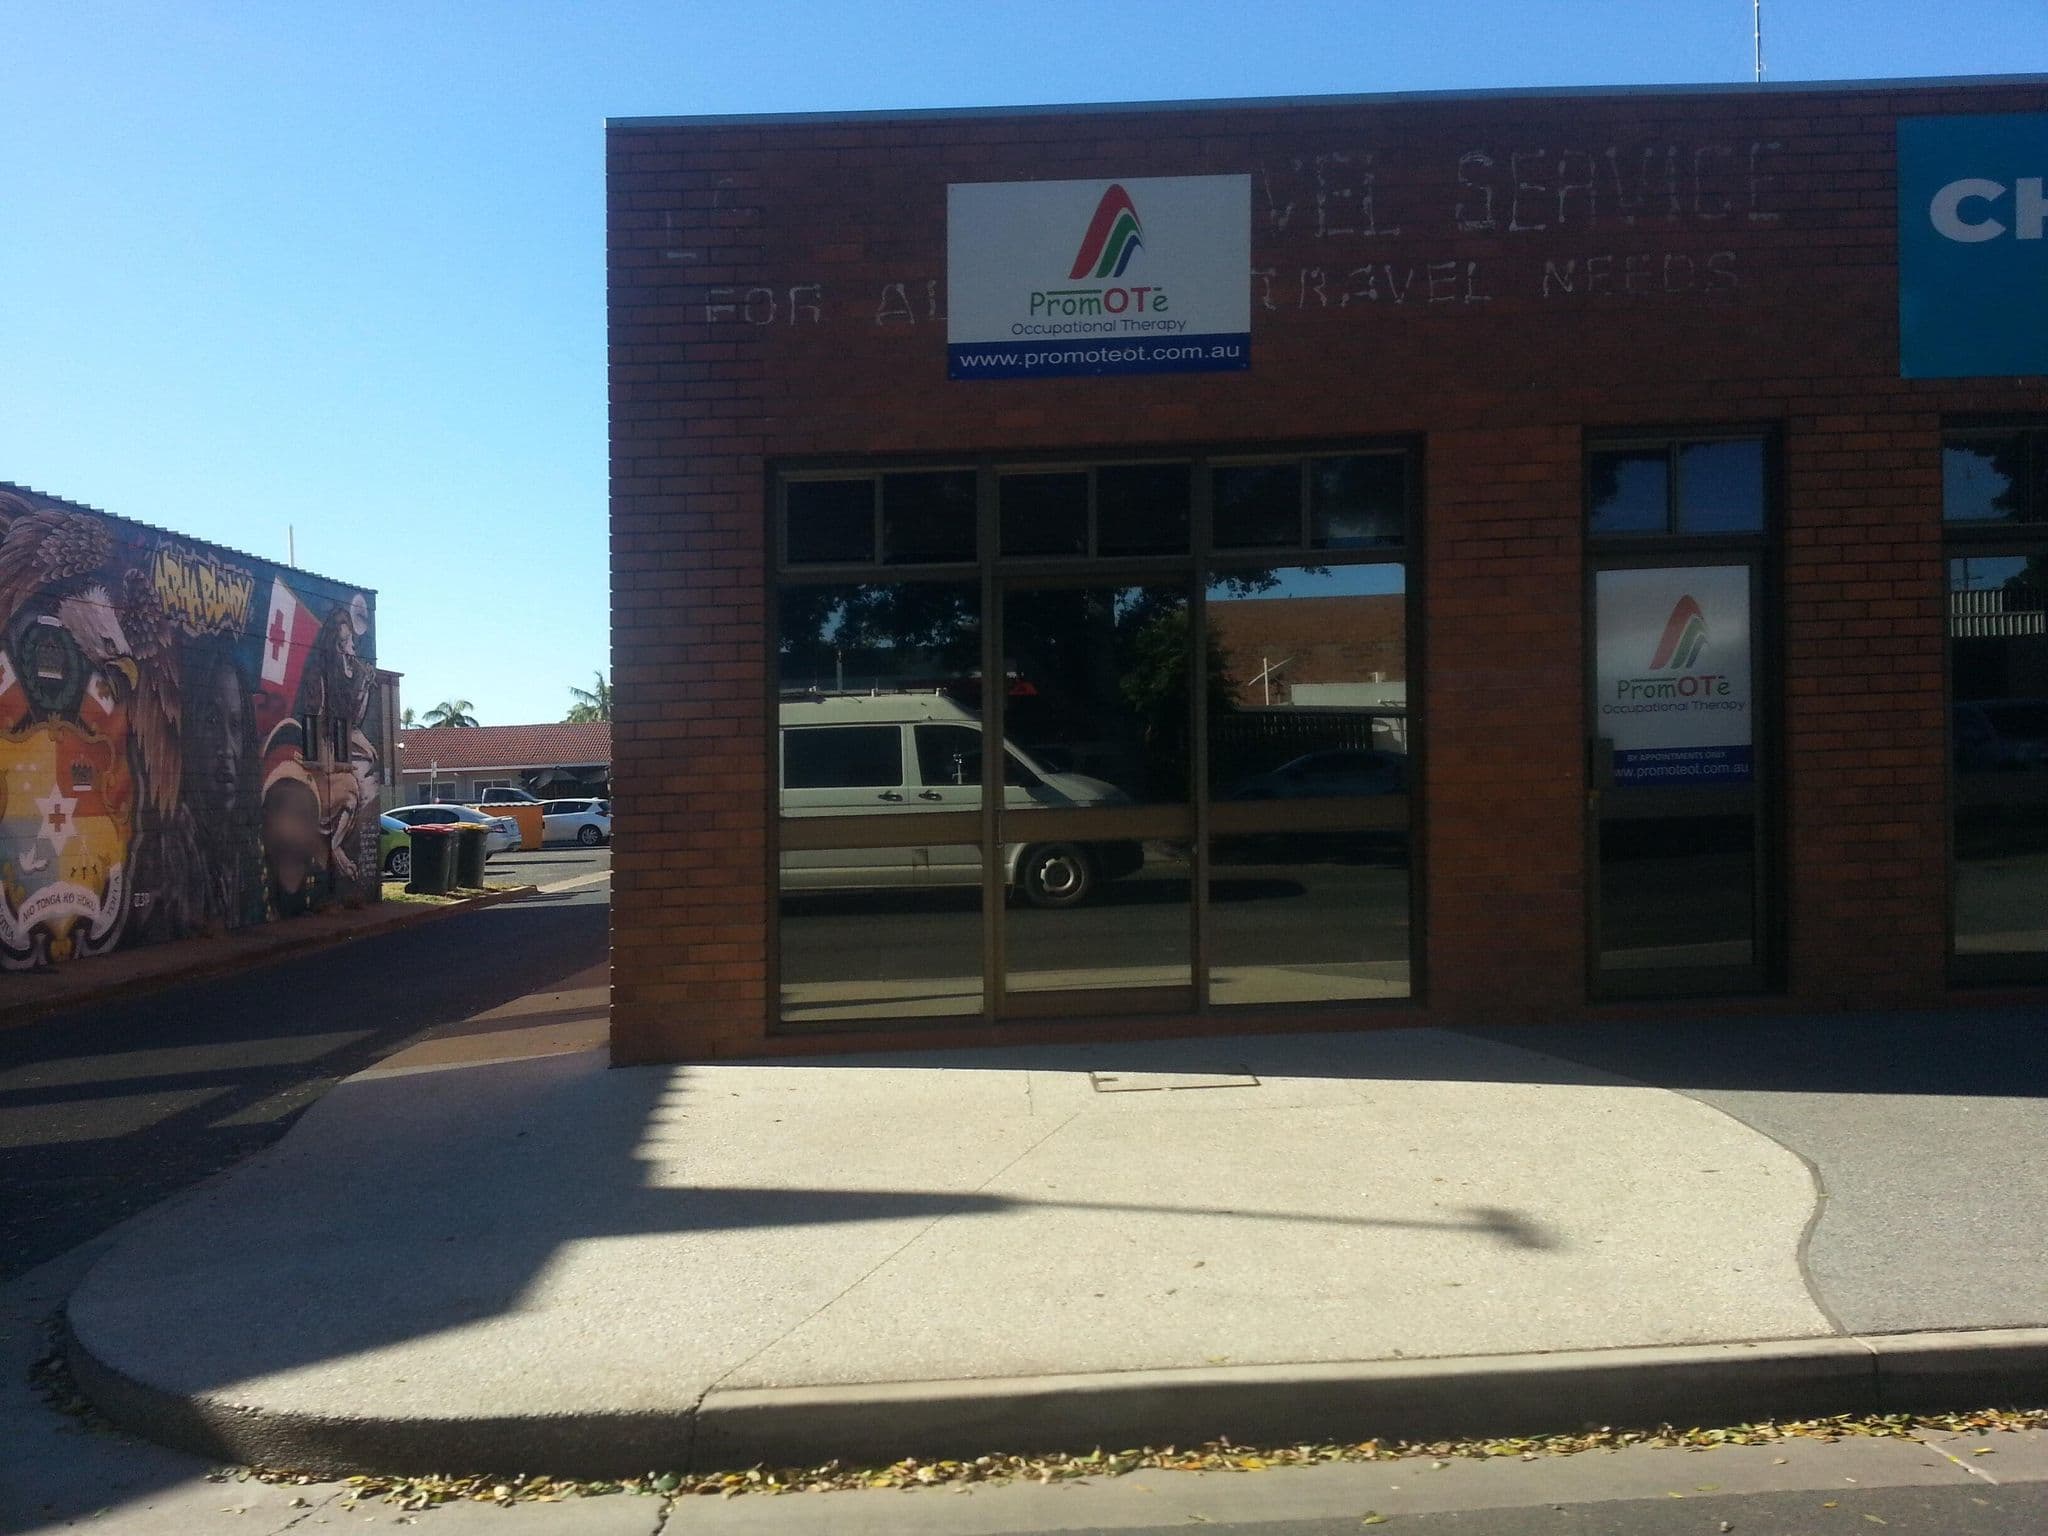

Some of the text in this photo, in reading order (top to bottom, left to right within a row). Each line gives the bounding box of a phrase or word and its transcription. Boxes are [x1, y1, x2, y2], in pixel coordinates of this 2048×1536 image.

[1454, 142, 1783, 233] SERVICE
[704, 283, 823, 326] FOR
[1011, 318, 1187, 336] Occupational Therapy
[959, 344, 1240, 369] www.promoteot.com.au
[1602, 700, 1746, 715] Occupational Therapy
[1614, 763, 1749, 779] ww.promoteot.com.au
[36, 893, 62, 912] TONGA
